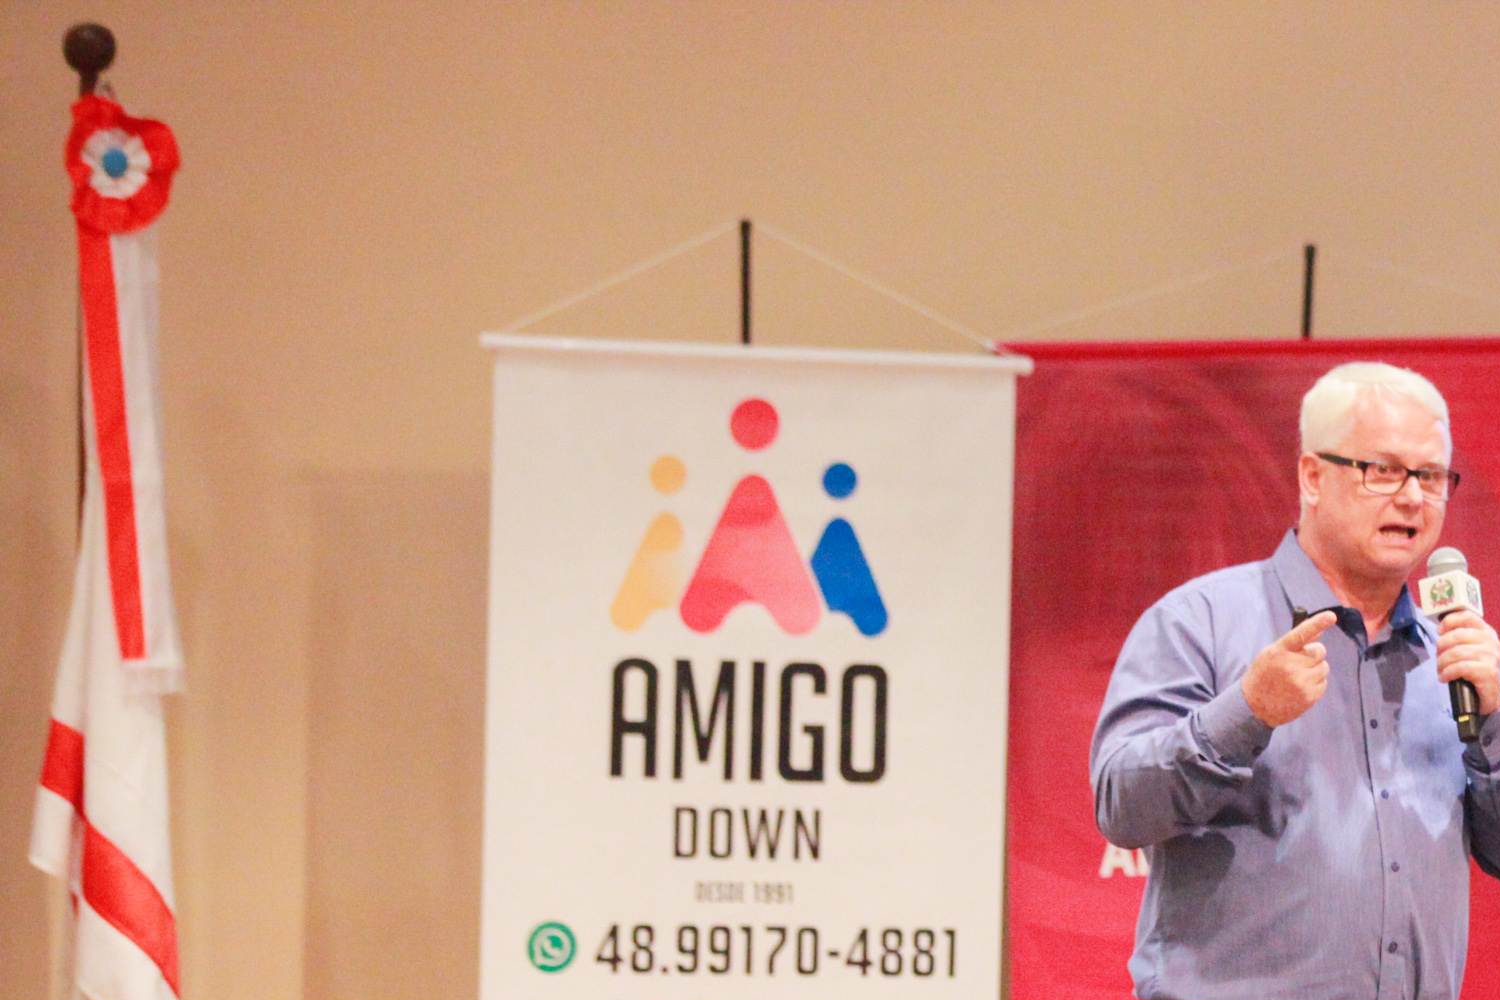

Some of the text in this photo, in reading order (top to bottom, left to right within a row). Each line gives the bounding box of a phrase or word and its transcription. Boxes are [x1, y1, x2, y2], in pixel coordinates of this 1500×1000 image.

[609, 657, 889, 784] AMIGO
[673, 806, 822, 861] DOWN
[694, 881, 794, 904] DESDE 1991
[596, 924, 957, 978] 48.99170-4881
